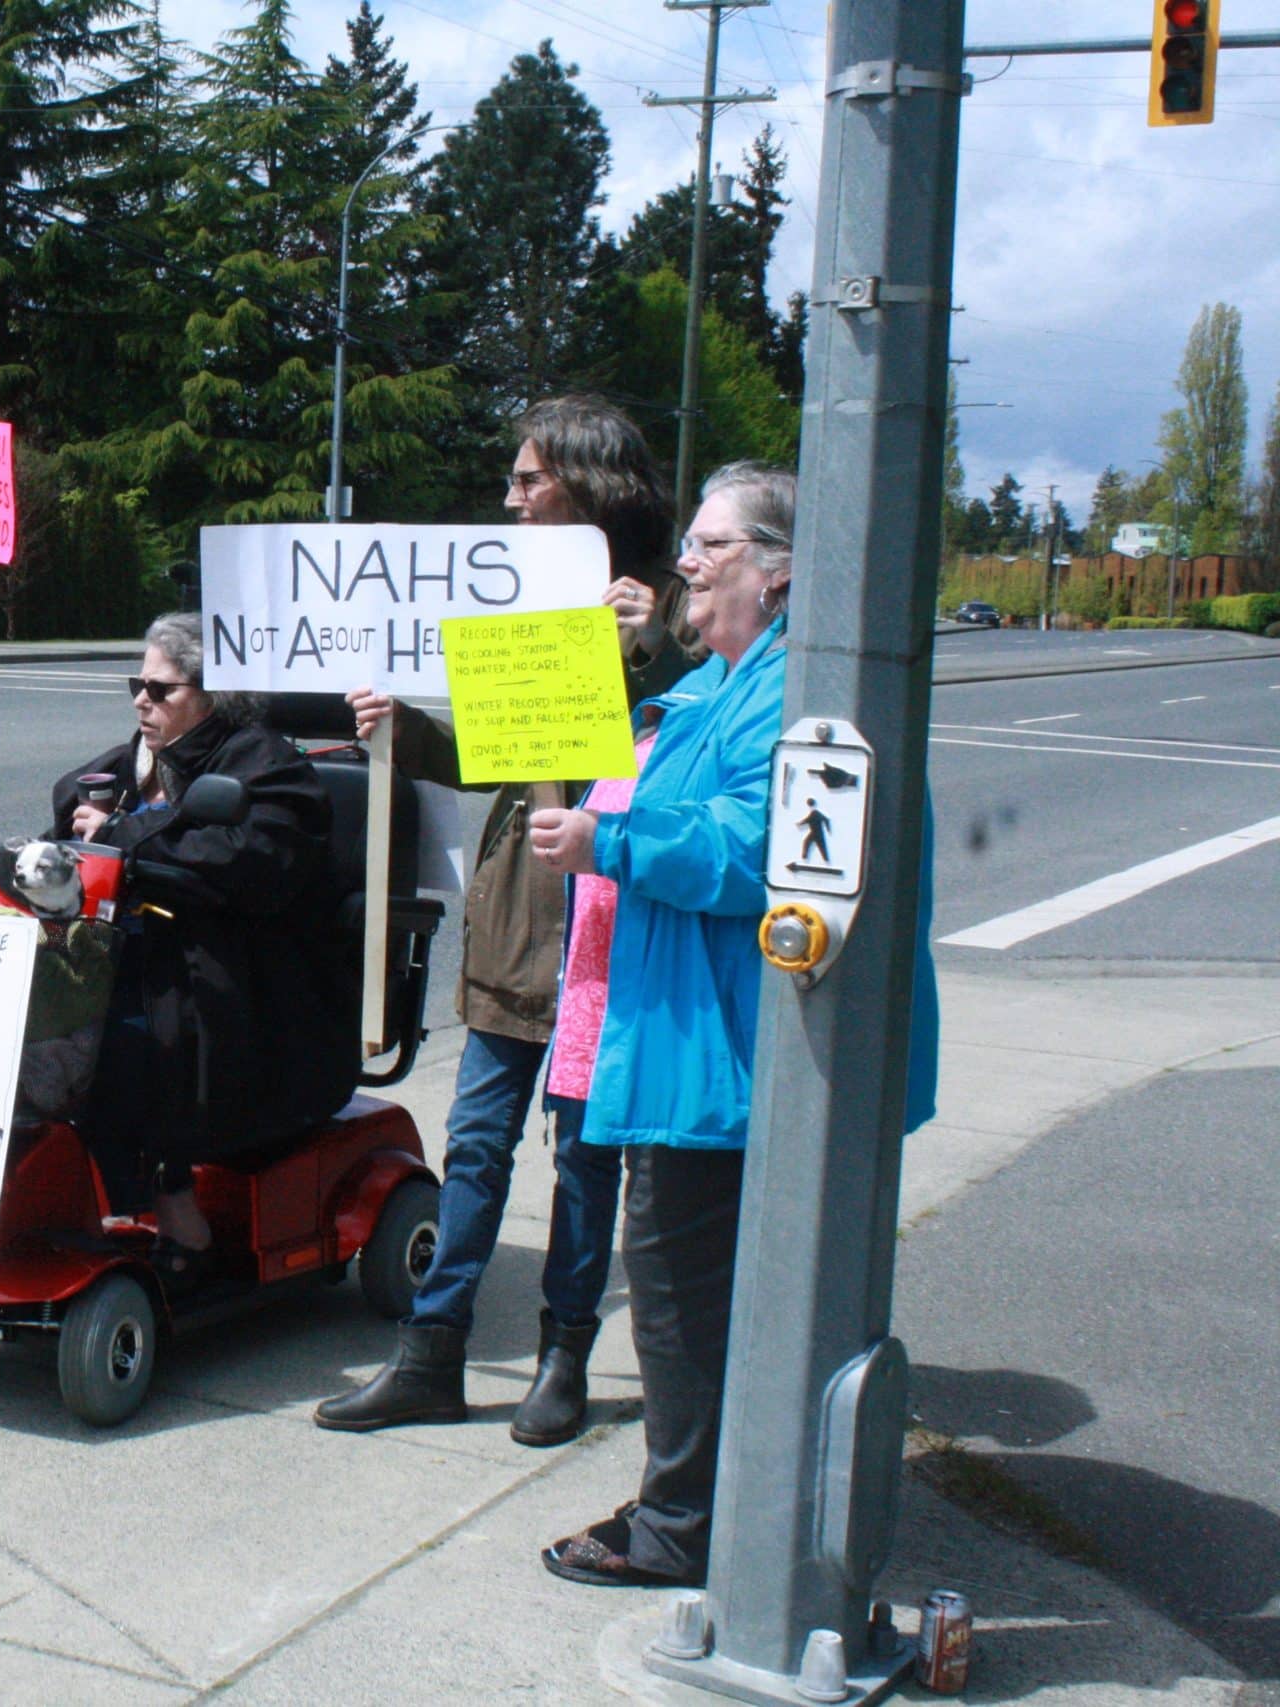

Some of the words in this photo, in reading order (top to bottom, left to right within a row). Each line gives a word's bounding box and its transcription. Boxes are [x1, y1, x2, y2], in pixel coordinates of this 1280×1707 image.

[292, 538, 521, 605] NAHS
[459, 626, 505, 641] RECORD
[511, 623, 542, 640] HEAT
[387, 618, 445, 672] HEL
[455, 650, 469, 661] NO
[472, 649, 511, 659] COOLING
[518, 643, 557, 656] STATION
[455, 665, 470, 676] NO
[513, 661, 527, 672] NO
[464, 698, 502, 713] WINTER
[508, 696, 550, 710] RECORD
[554, 693, 599, 706] NUMBER
[466, 716, 479, 727] OF
[485, 715, 506, 727] SLIP
[510, 714, 532, 726] AND
[574, 712, 594, 722] WHO
[557, 738, 589, 750] DOWN
[491, 758, 514, 769] WHO
